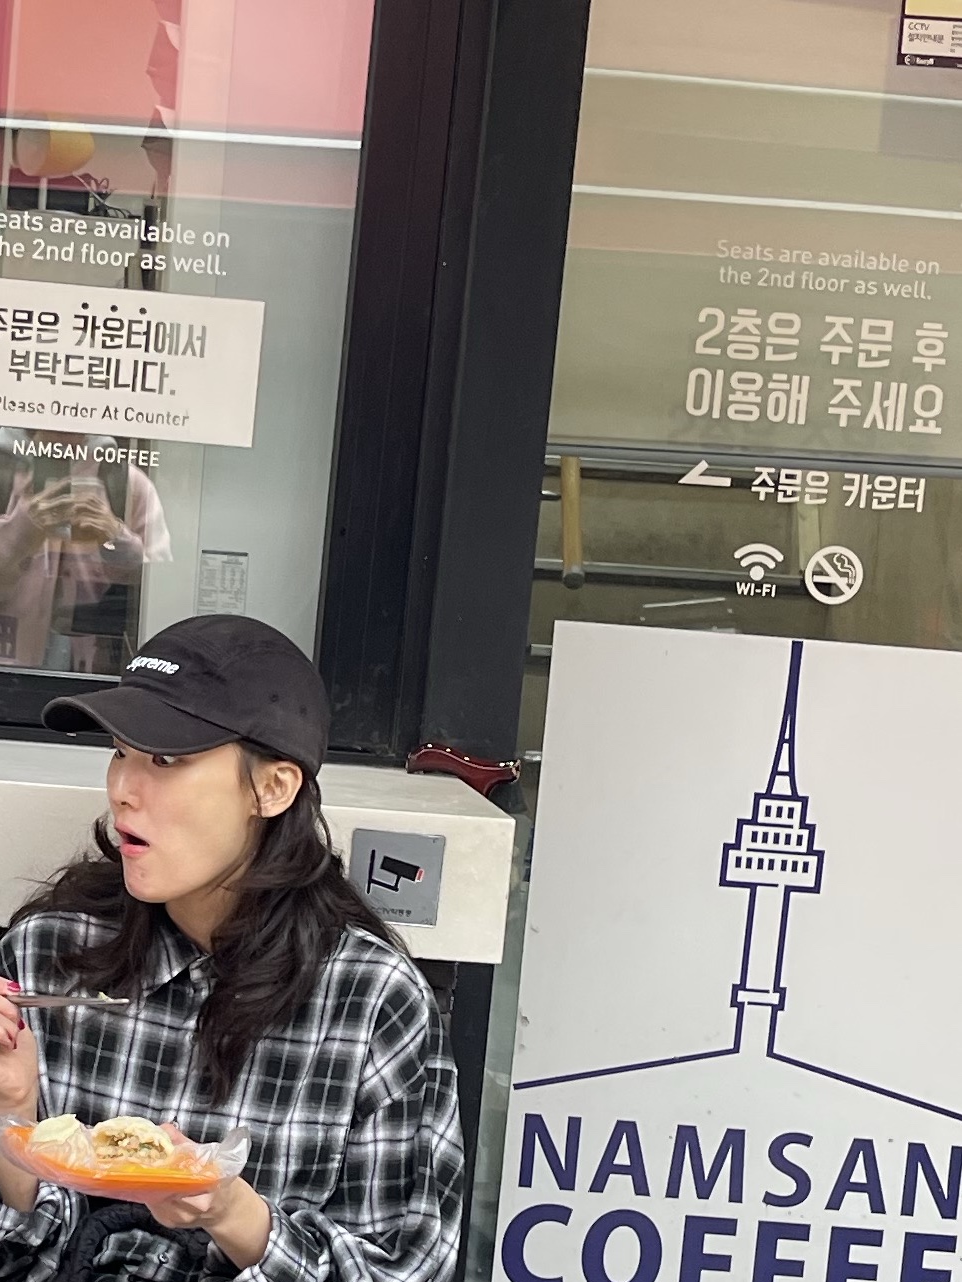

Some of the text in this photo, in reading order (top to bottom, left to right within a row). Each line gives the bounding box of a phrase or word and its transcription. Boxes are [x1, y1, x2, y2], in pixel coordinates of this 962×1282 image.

[908, 22, 930, 31] CCTV
[49, 217, 88, 236] are
[93, 219, 196, 244] available
[202, 231, 230, 248] on
[32, 239, 75, 262] 2nd
[81, 243, 134, 267] floor
[140, 253, 167, 271] as
[173, 254, 227, 276] well.
[716, 240, 940, 275] Seats are available on
[719, 266, 932, 300] the 2nd floor as well.
[72, 313, 207, 359] 카운터에서
[694, 307, 949, 373] 2층은 주문 후
[8, 349, 176, 396] 부탁드립니다.
[50, 400, 98, 420] Order
[101, 405, 119, 421] At
[124, 407, 189, 427] Counter
[685, 367, 944, 435] 이용해 주세요
[12, 439, 160, 467] NAMSAN COFFEE
[751, 466, 925, 513] 주문은 카운터
[736, 582, 776, 597] WI-FI
[126, 656, 180, 675] preme
[518, 1113, 962, 1220] NAMSAN
